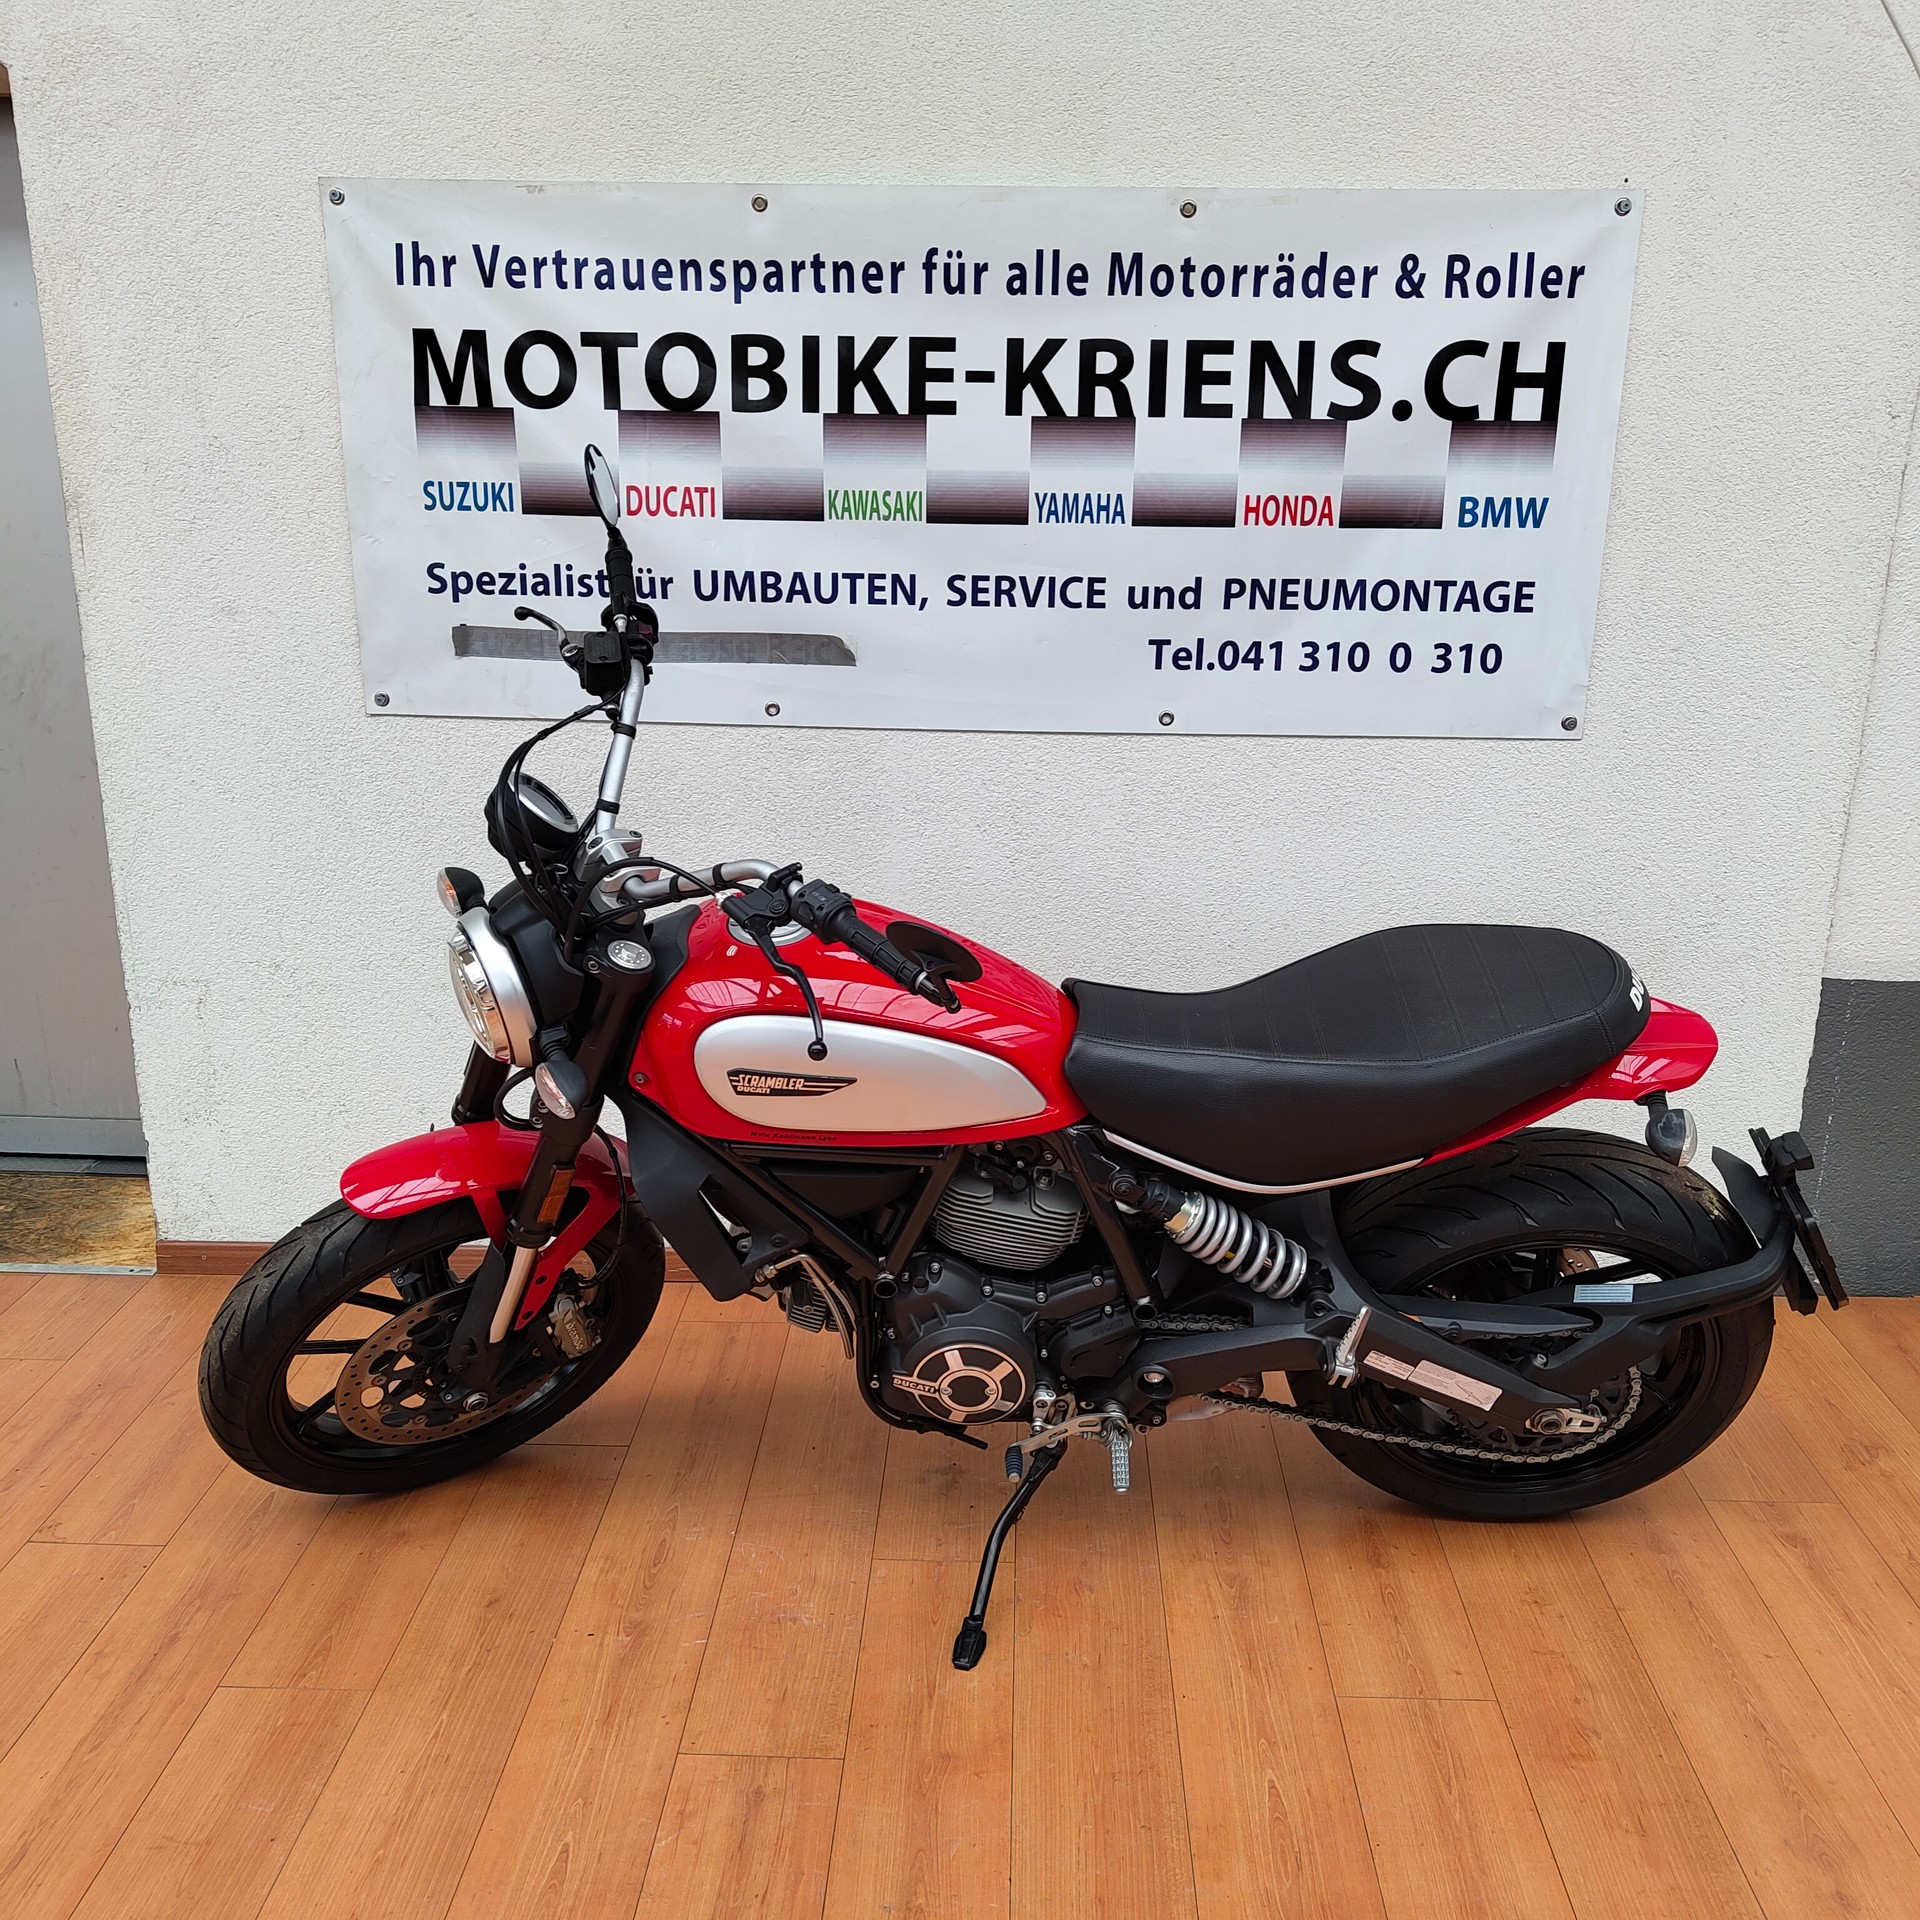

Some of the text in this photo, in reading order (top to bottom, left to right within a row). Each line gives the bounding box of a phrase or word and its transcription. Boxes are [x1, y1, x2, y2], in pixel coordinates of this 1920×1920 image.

[396, 241, 1585, 304] Ihr Vertrauenspartner für alle Motorräder & Roller
[412, 328, 1566, 423] MOTOBIKE-KRIENS.CH
[423, 481, 1549, 529] SUZUKI DUCATI KAWASAKI YAMAHA HONDA BMW
[427, 562, 1535, 614] Spezialist ür UMBAUTEN, SERVICE und PNEUMONTAGE
[1148, 638, 1503, 675] Tel.041 310 0 310
[736, 1086, 770, 1094] DUCATI
[738, 1073, 805, 1090] SCRAMBLER
[892, 1378, 935, 1393] DUCATI
